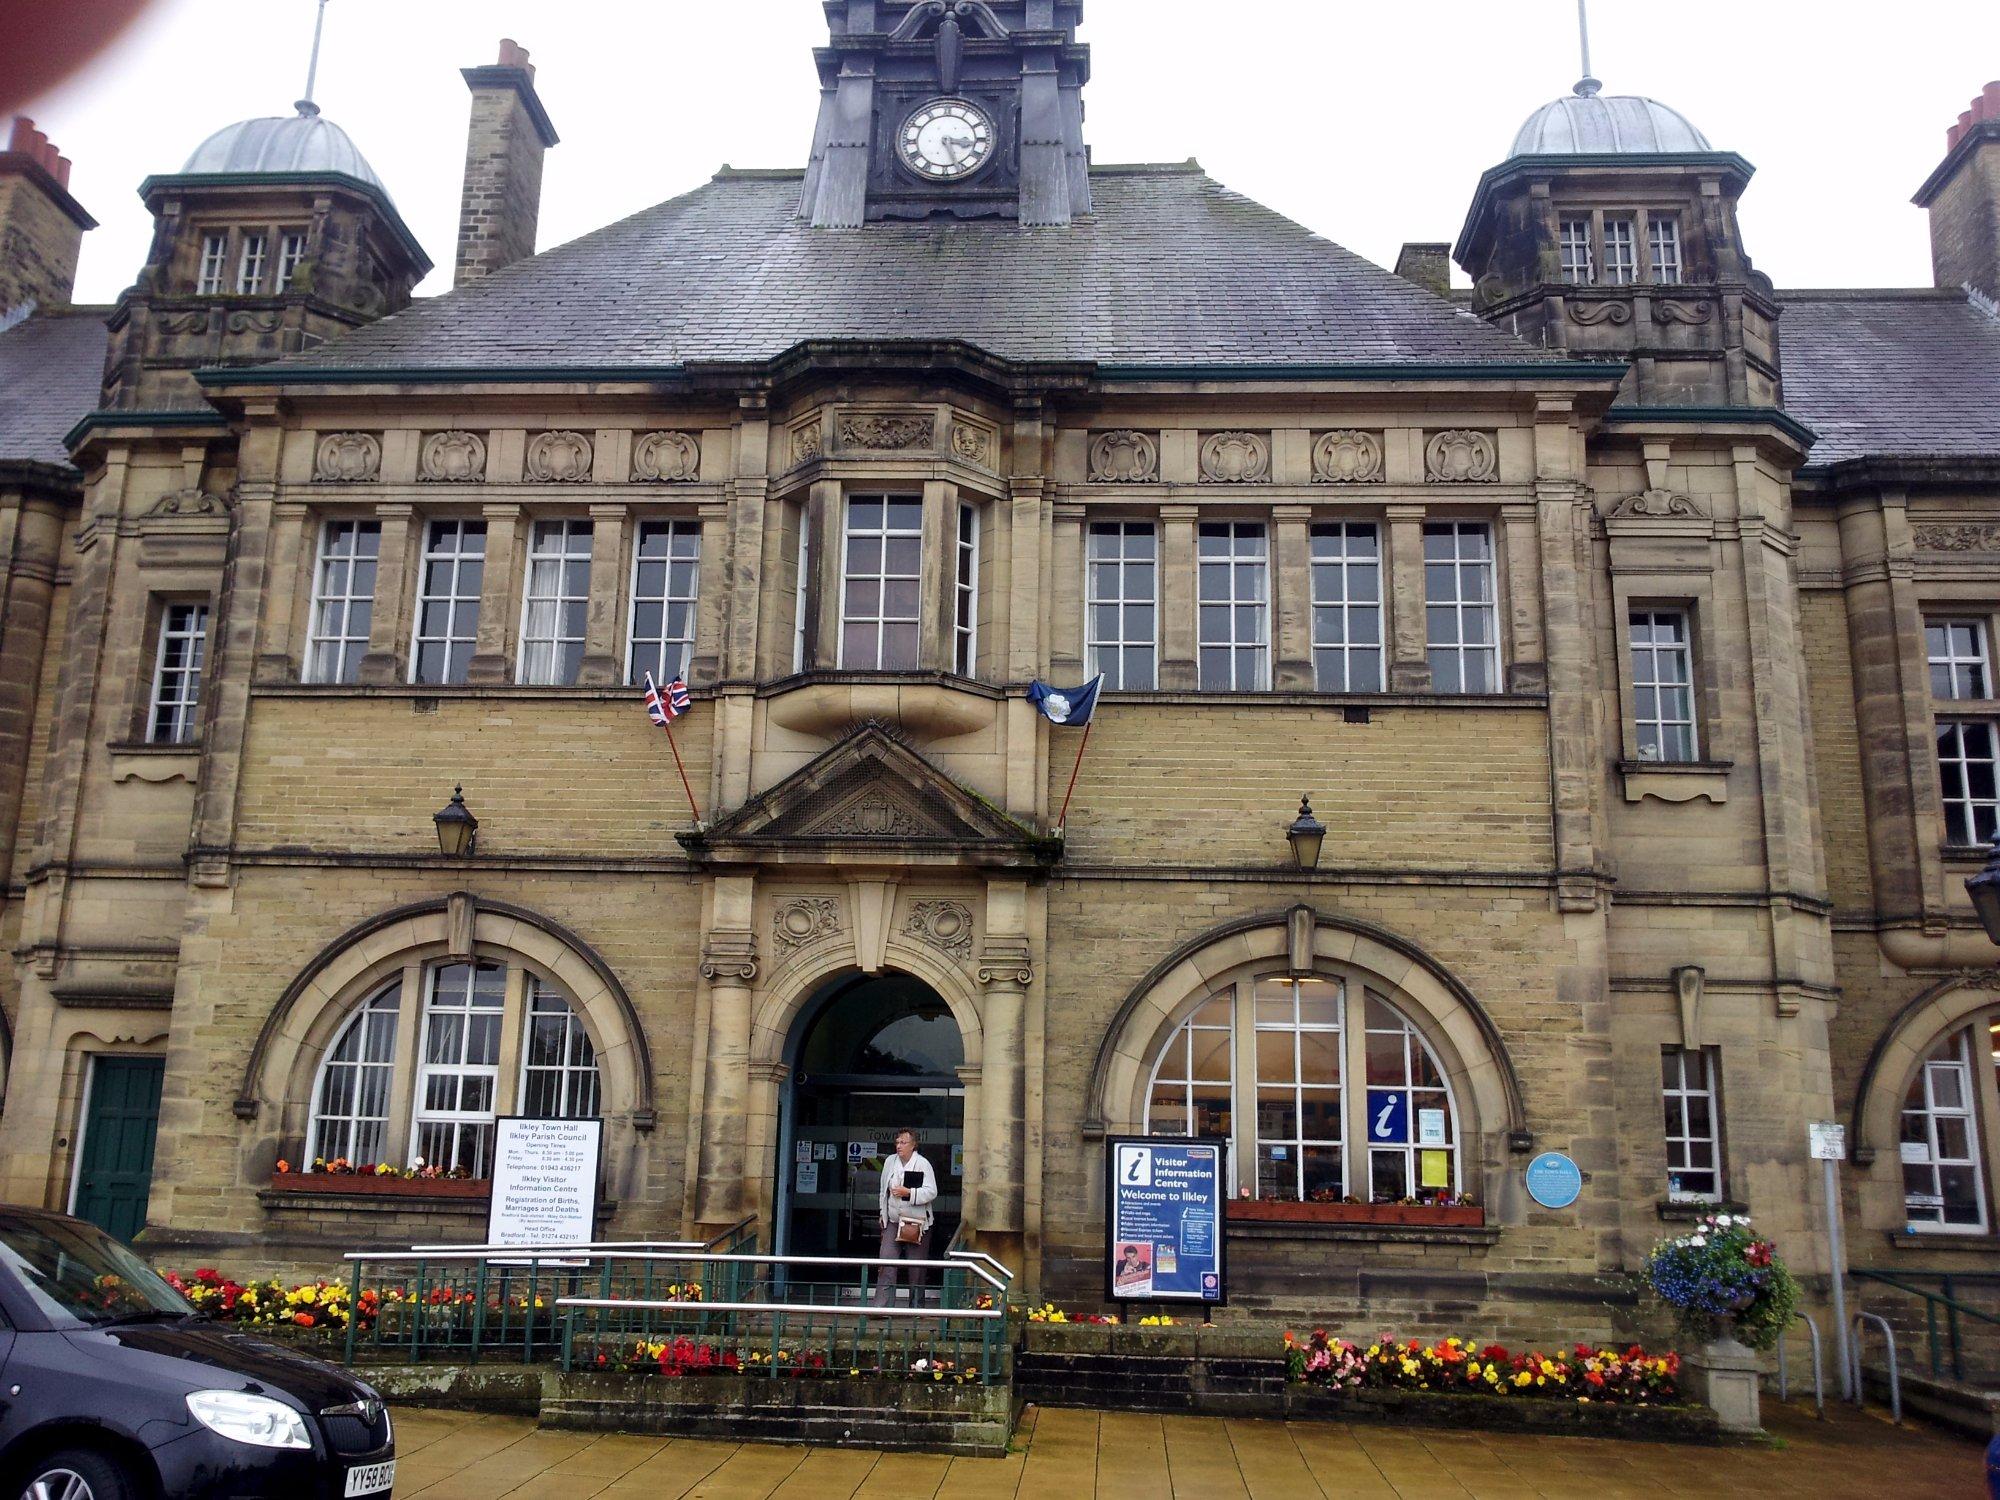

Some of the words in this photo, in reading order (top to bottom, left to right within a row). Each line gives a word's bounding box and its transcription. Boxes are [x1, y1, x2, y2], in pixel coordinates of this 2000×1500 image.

[510, 1132, 530, 1140] Ilkley
[1155, 1158, 1187, 1166] Visitor
[1155, 1168, 1212, 1178] Information
[1155, 1179, 1188, 1188] Centre
[1121, 1190, 1166, 1200] Welcome
[1169, 1191, 1179, 1200] to
[1183, 1191, 1208, 1203] Ilkley
[352, 1467, 378, 1491] YY58
